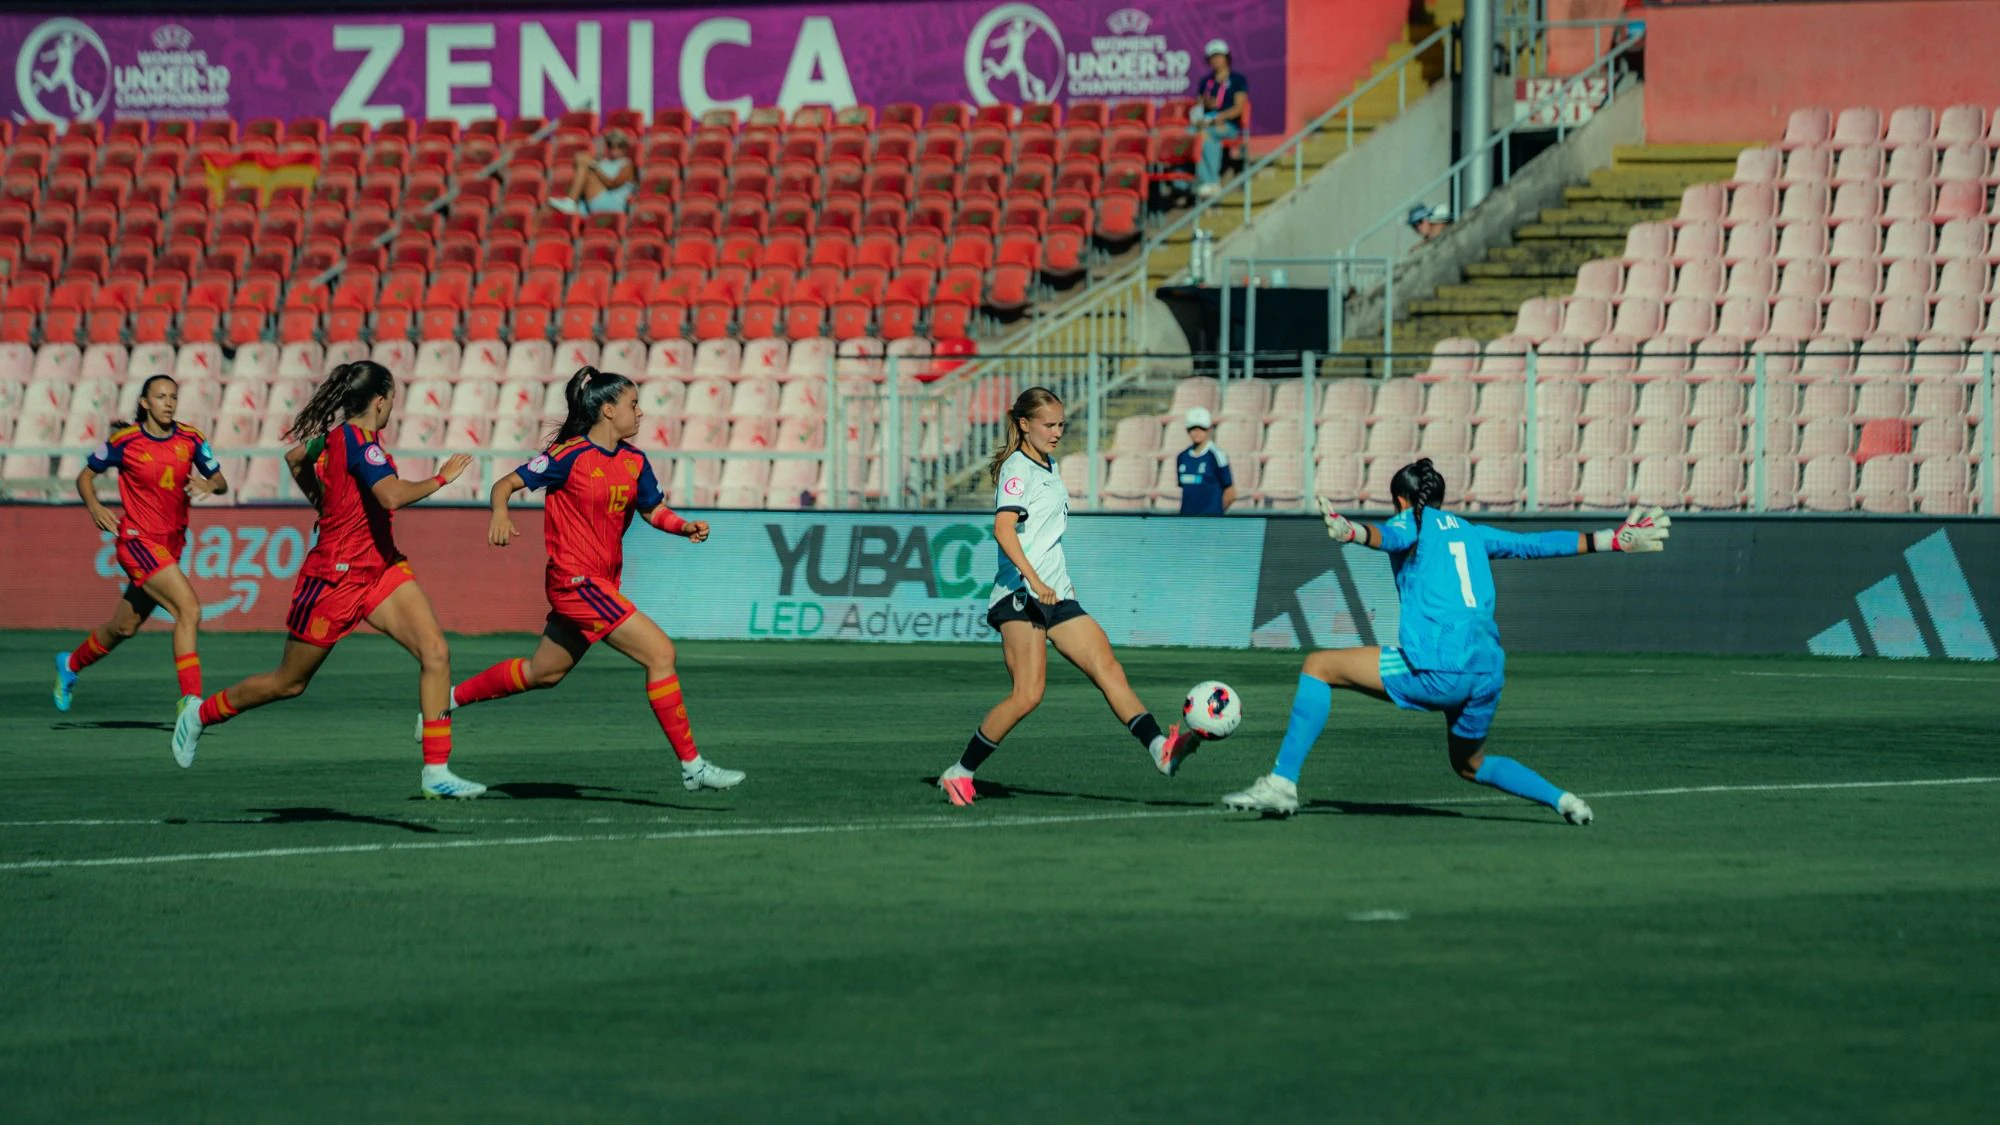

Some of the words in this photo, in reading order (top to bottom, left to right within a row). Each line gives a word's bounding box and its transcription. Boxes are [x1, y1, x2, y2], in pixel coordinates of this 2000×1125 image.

[329, 16, 857, 131] ZENICA
[1067, 50, 1191, 79] UNDER-19
[114, 65, 231, 93] UNDER-19
[1067, 76, 1190, 96] CHAMPIONSHIP
[115, 89, 230, 108] CHAMPIONSHIP
[159, 465, 176, 491] 4
[608, 485, 630, 513] 15
[95, 525, 320, 580] aazo
[1448, 541, 1477, 608] 1
[749, 602, 825, 636] LED
[839, 603, 1000, 639] Advertis
